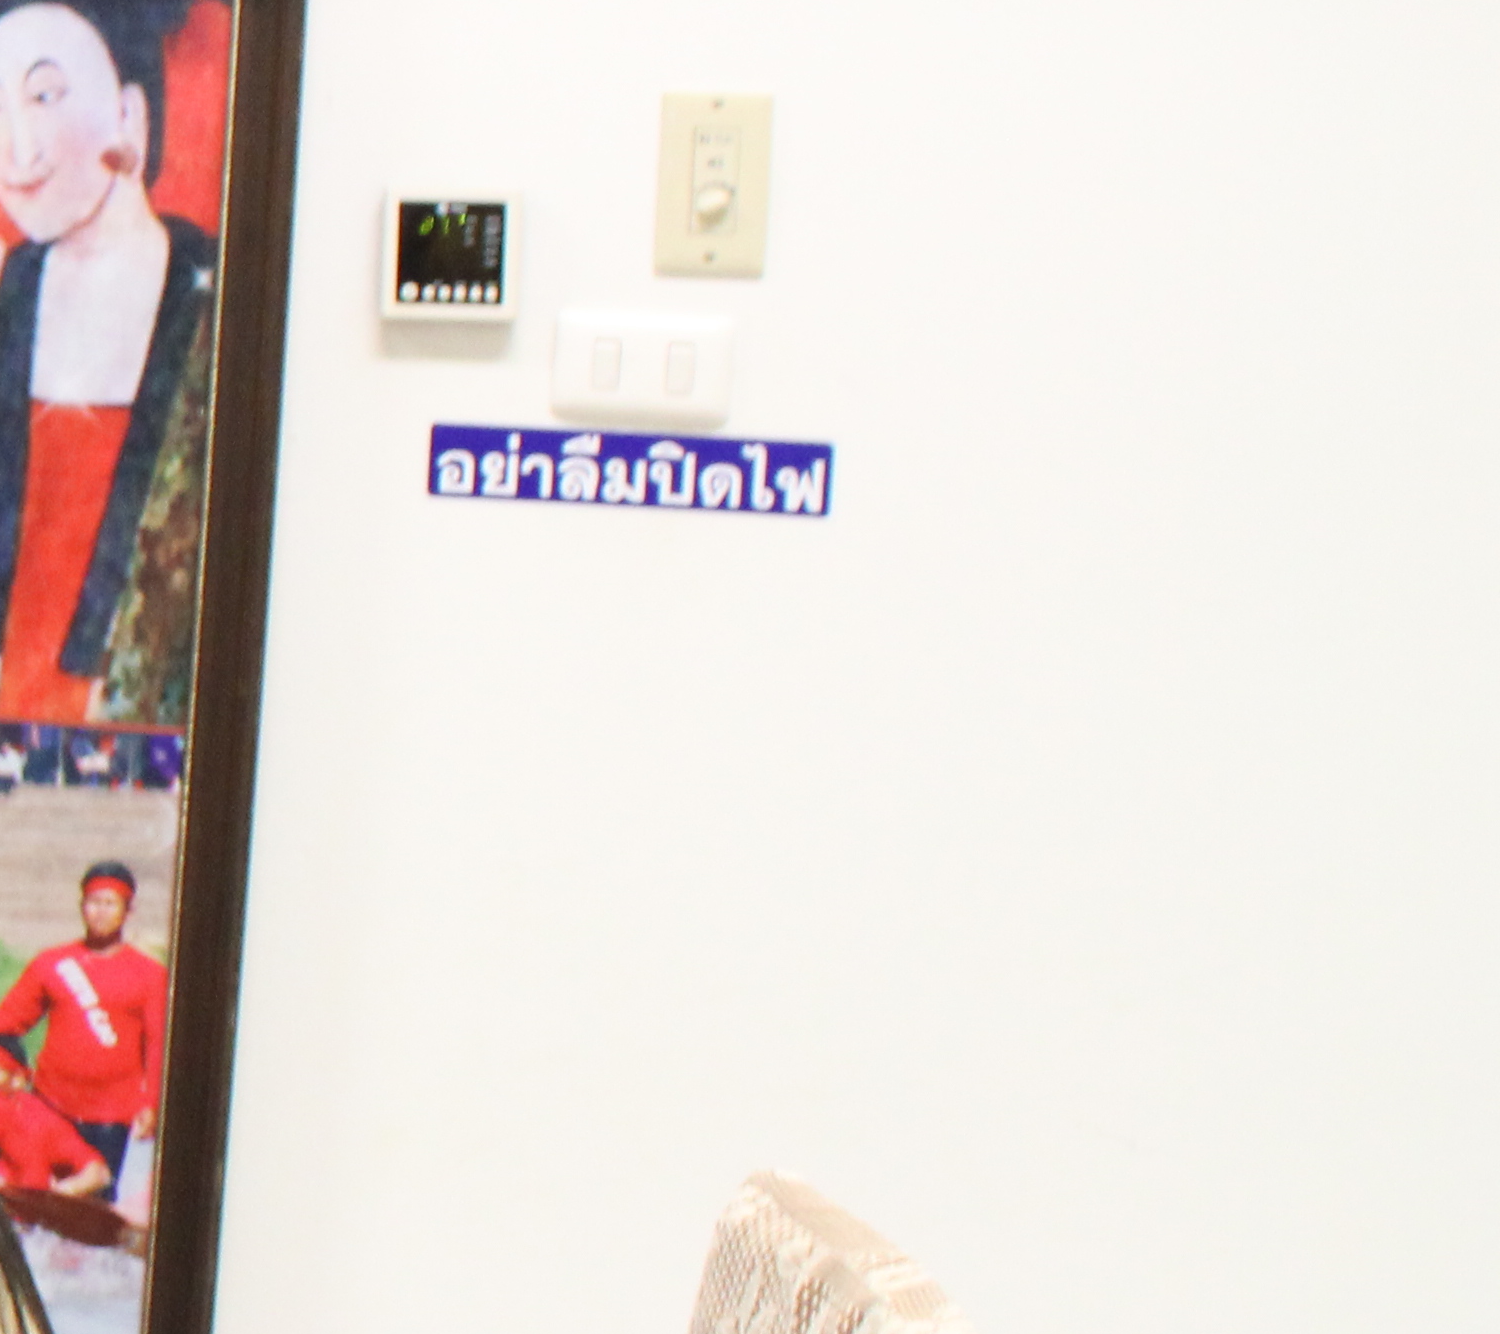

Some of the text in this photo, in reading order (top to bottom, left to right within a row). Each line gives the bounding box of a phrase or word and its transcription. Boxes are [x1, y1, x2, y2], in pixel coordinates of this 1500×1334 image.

[435, 433, 826, 515] อย่าลืมปิดไฟ
